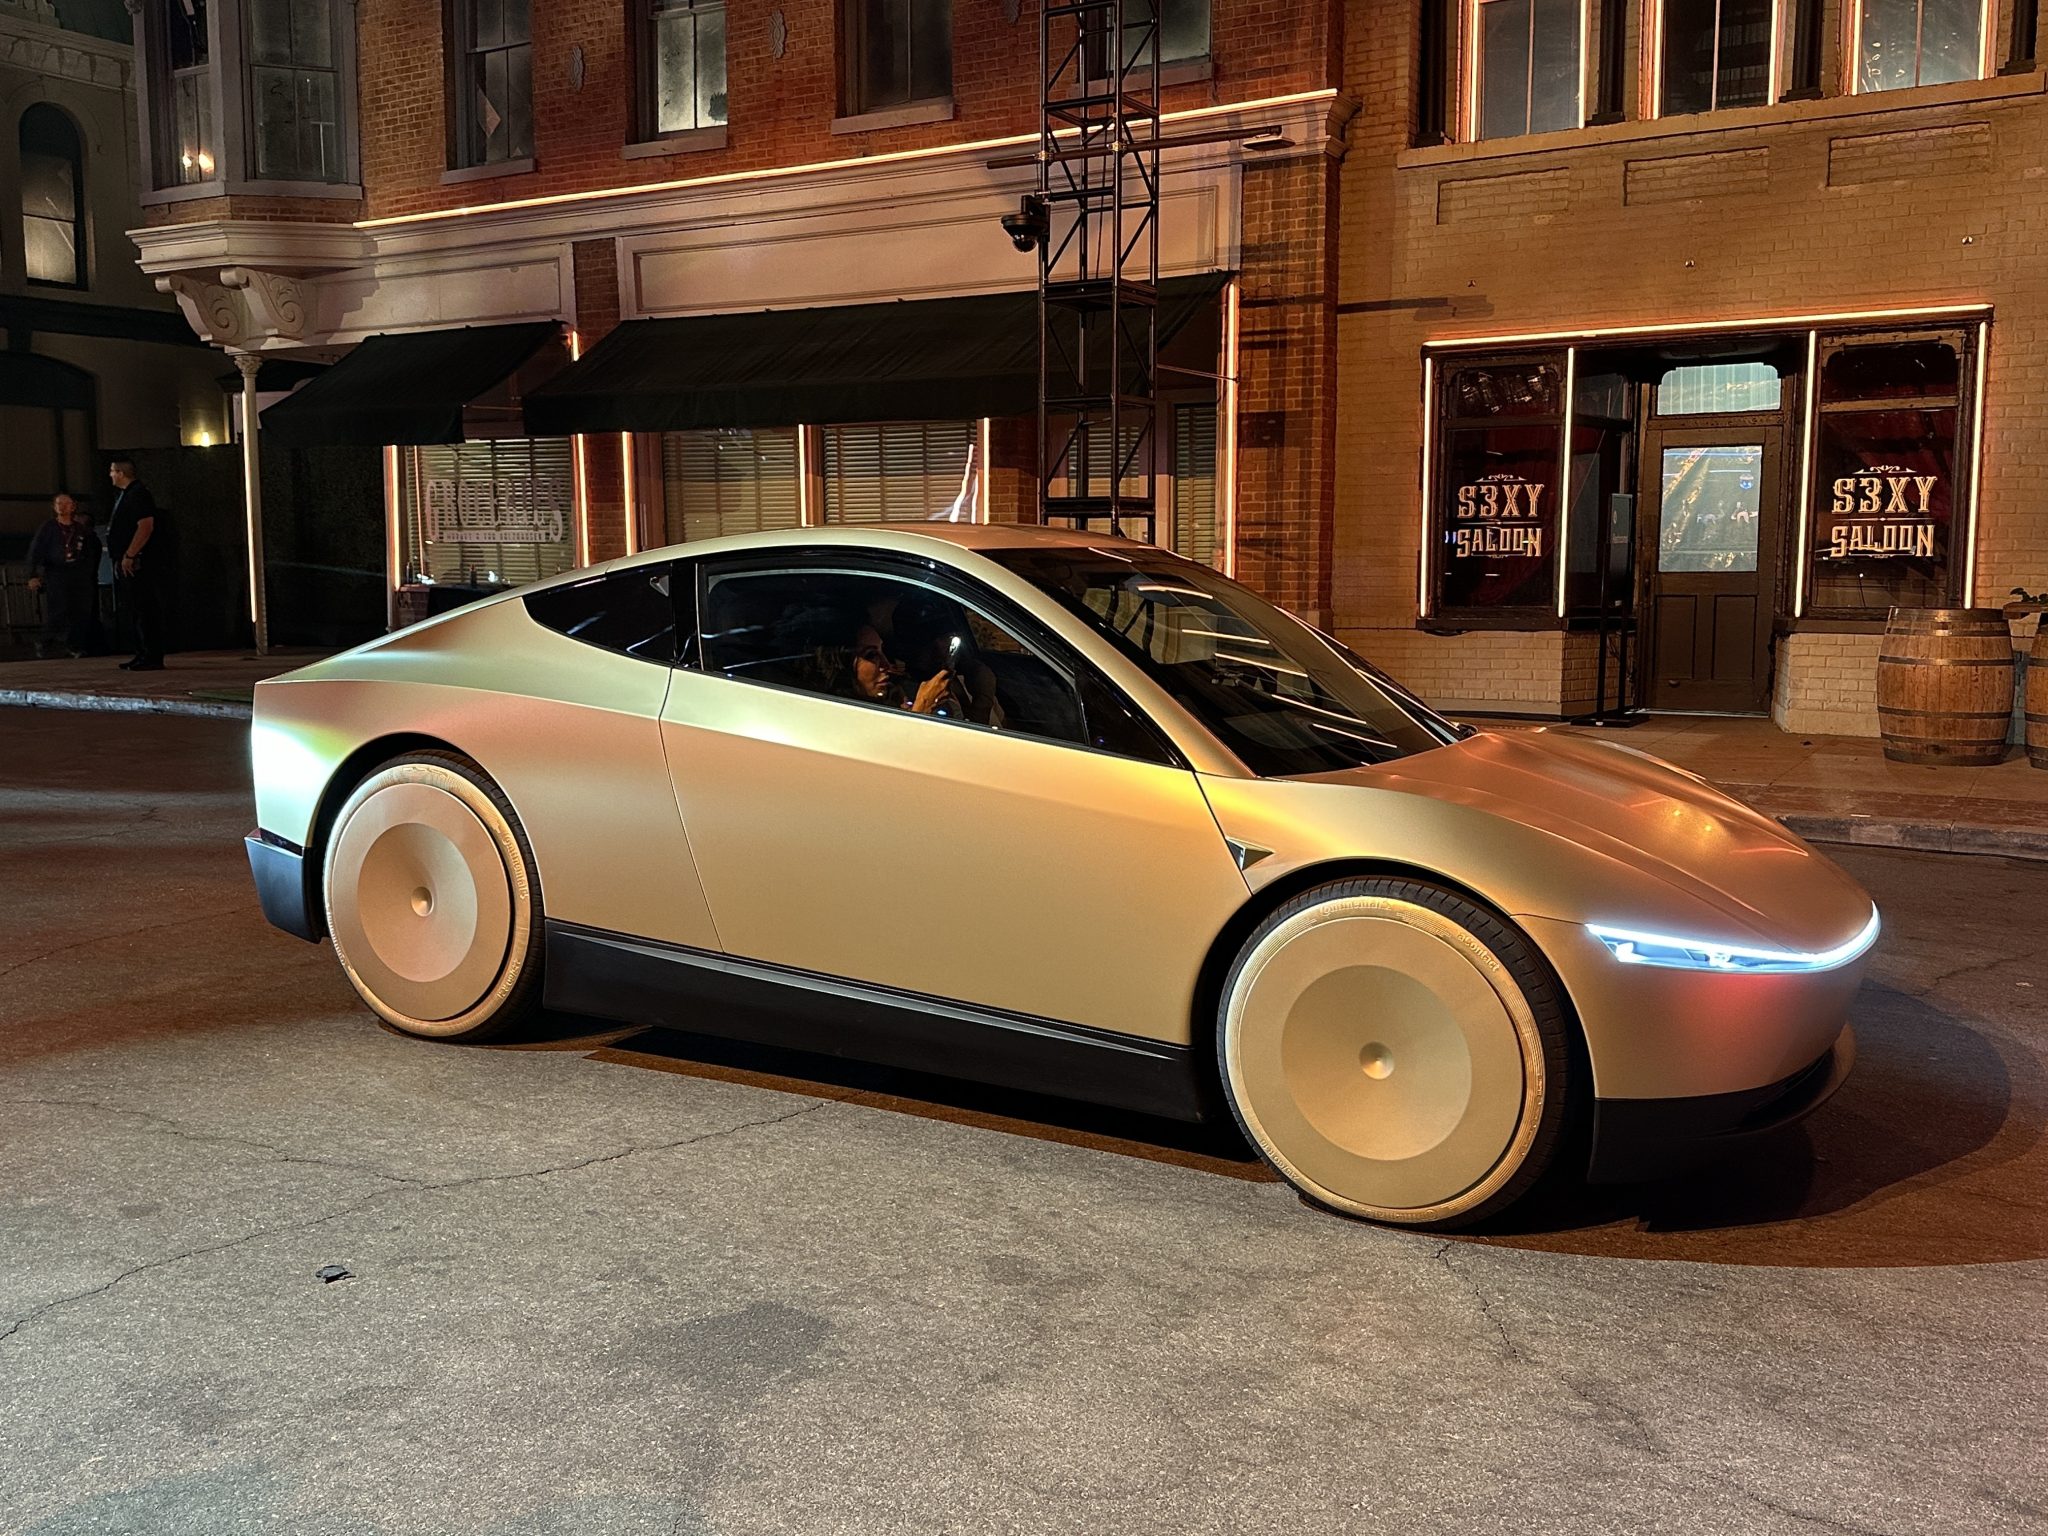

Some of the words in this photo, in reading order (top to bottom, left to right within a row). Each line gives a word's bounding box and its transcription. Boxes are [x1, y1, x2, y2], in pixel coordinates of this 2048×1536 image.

[1457, 484, 1545, 518] S3XY
[1830, 476, 1938, 514] S3XY
[1456, 528, 1542, 557] SALOON
[1830, 525, 1935, 557] SALOON
